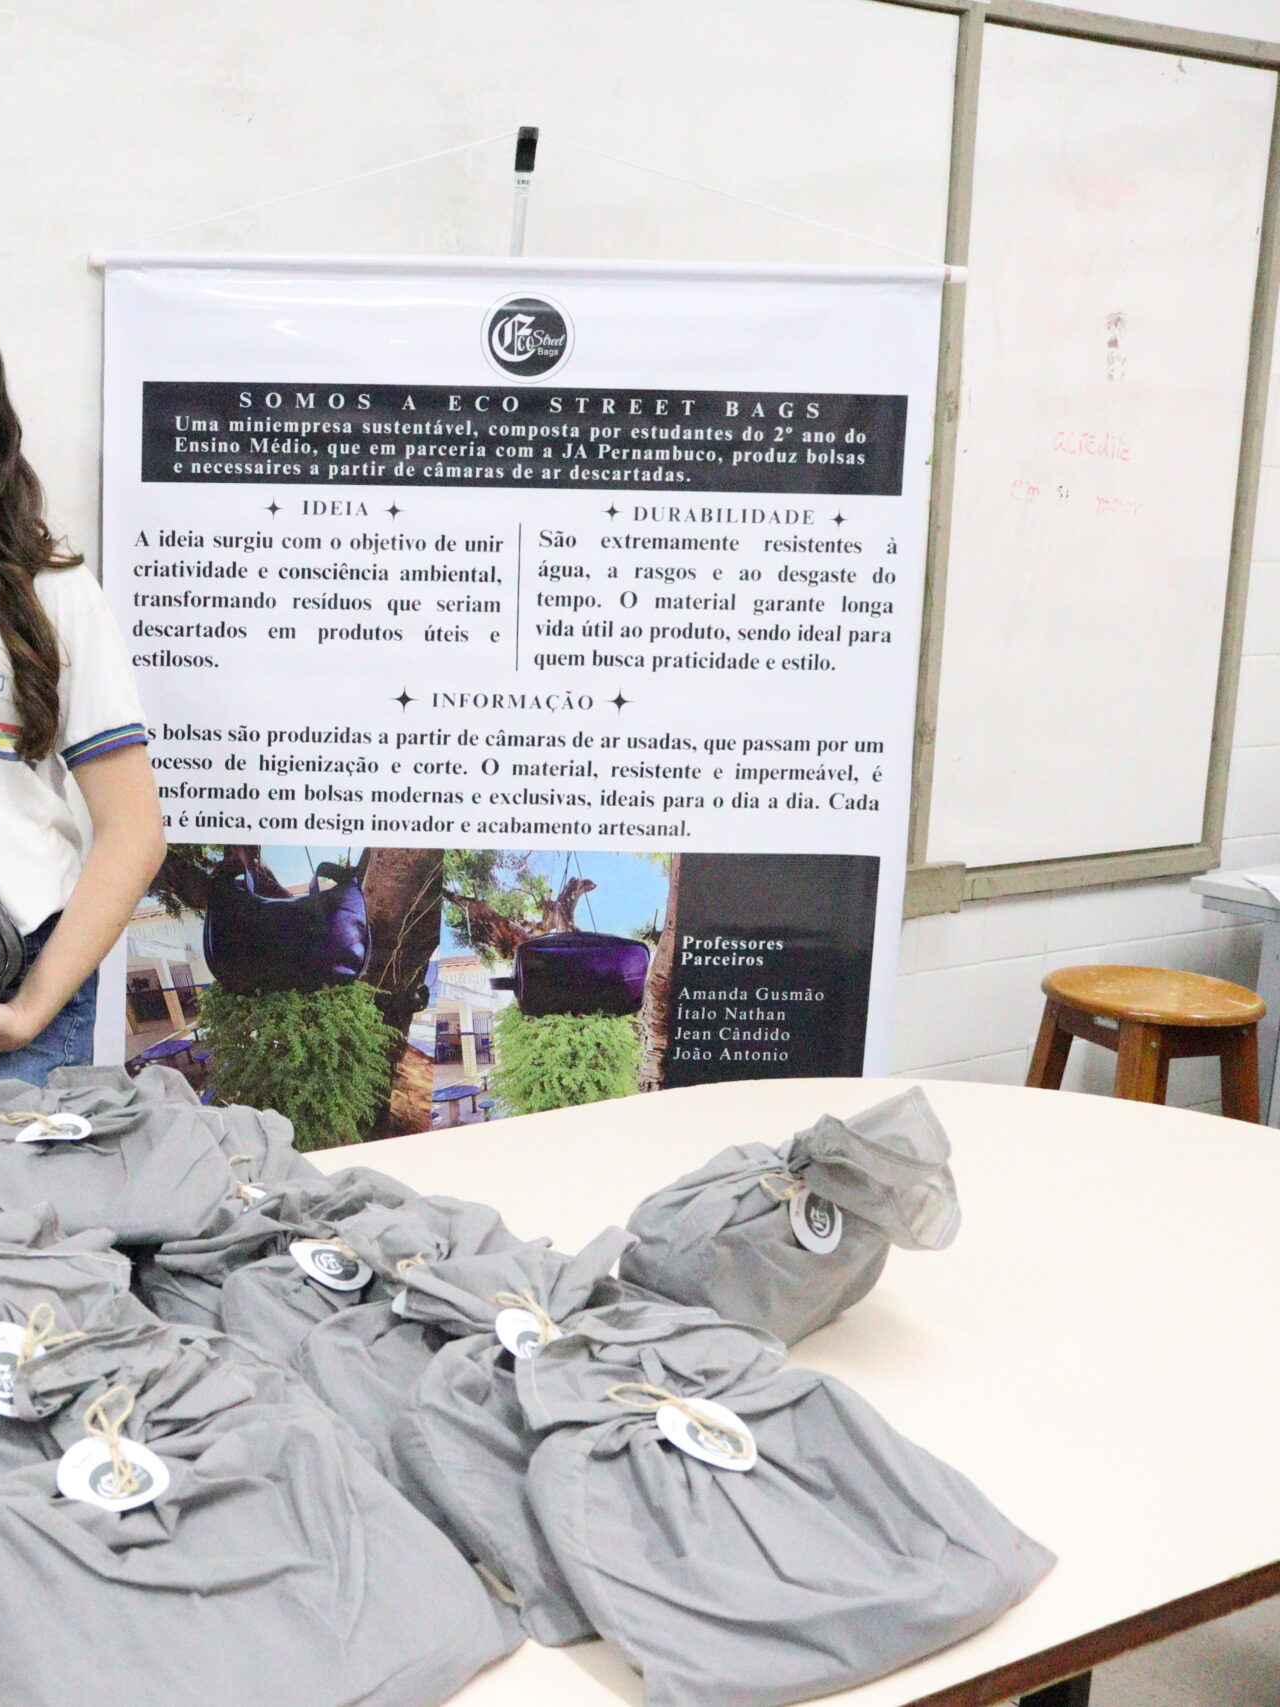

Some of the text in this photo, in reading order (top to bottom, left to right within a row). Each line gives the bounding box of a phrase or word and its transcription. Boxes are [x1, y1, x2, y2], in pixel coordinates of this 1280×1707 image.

[537, 347, 559, 357] Bags
[239, 391, 819, 419] SOMOS A ECO STREET BAGS
[175, 415, 219, 432] Uma
[229, 416, 352, 437] miniempresa
[362, 419, 478, 438] sustentável,
[488, 423, 580, 441] composta
[590, 427, 622, 442] por
[630, 424, 733, 441] estudantes
[742, 426, 764, 442] do
[802, 431, 836, 443] ano
[844, 428, 866, 444] do
[175, 437, 865, 466] Ensino Médio, que em parceria com a JA Pernambuco, produz bolsas
[173, 459, 691, 482] e necessaires a partir de câmaras de ar descartadas.
[303, 500, 368, 516] IDEIA
[634, 506, 814, 525] DURABILIDADE
[134, 529, 504, 555] A ideia surgiu com o objetivo de unir
[539, 529, 897, 555] São extremamente resistentes à
[133, 559, 502, 585] criatividade e consciência ambiental,
[538, 559, 896, 587] água, a rasgos e ao desgaste do
[133, 590, 501, 616] transformando resíduos que seriam
[537, 591, 893, 617] tempo. O material garante longa
[132, 619, 500, 645] descartados em produtos úteis e
[536, 619, 891, 647] vida útil ao produto, sendo ideal para
[132, 649, 219, 668] estilosos.
[534, 649, 836, 673] quem busca praticidade e estilo.
[433, 690, 593, 713] INFORMAÇÃO
[163, 723, 222, 742] bolsas
[228, 725, 261, 742] são
[267, 726, 372, 747] produzidas
[378, 732, 389, 745] a
[396, 728, 451, 750] partir
[457, 729, 479, 746] de
[485, 729, 566, 748] câmaras
[572, 731, 594, 748] de
[600, 736, 621, 749] ar
[627, 732, 697, 751] usadas,
[703, 739, 737, 755] que
[742, 739, 810, 756] passam
[817, 740, 849, 757] por
[854, 740, 884, 754] um
[151, 753, 882, 785] ocesso de higienização e corte. O material, resistente e impermeável, é
[158, 781, 879, 813] nsformado em bolsas modernas e exclusivas, ideais para o dia a dia. Cada
[178, 810, 189, 828] é
[195, 810, 252, 831] única,
[258, 817, 298, 830] com
[304, 813, 364, 835] design
[371, 814, 455, 832] inovador
[460, 821, 471, 833] e
[477, 817, 592, 835] acabamento
[598, 820, 691, 837] artesanal.
[682, 935, 784, 951] Professores
[681, 951, 764, 966] Parceiros
[678, 987, 824, 1001] Amanda Gusmão
[677, 1003, 785, 1021] Ítalo Nathan
[674, 1027, 790, 1041] Jean Cândido
[673, 1047, 788, 1061] João Antonio
